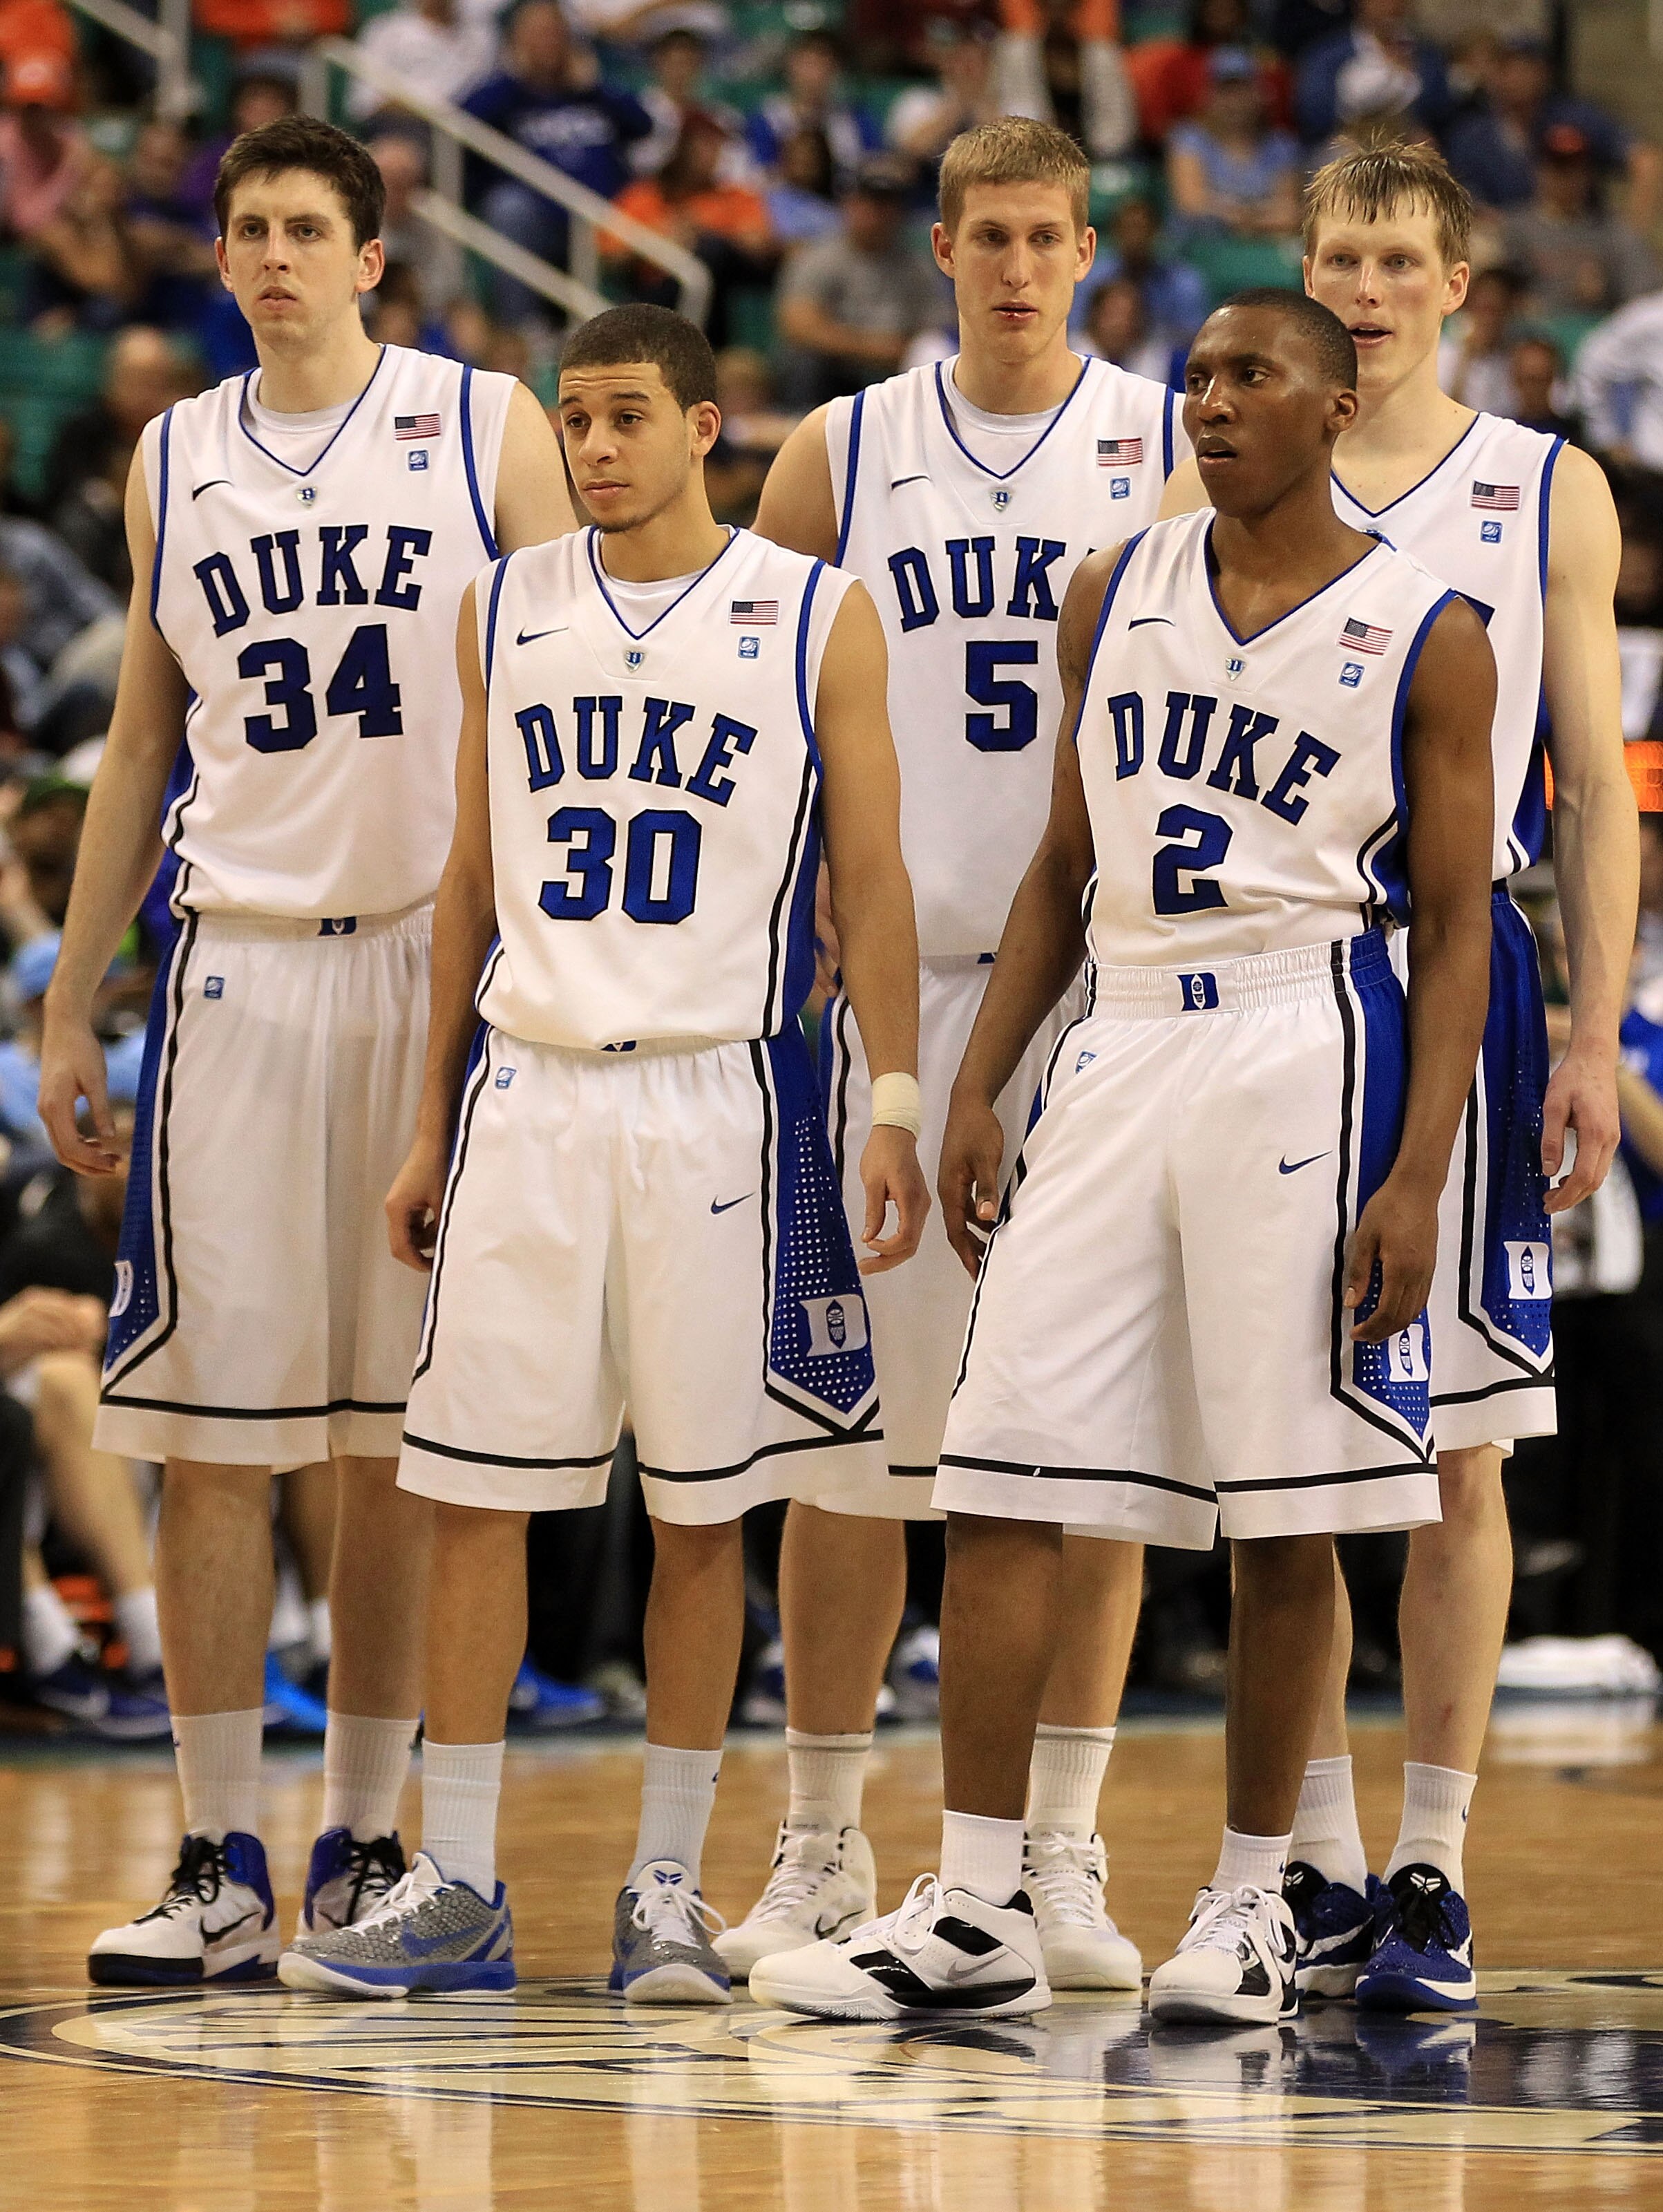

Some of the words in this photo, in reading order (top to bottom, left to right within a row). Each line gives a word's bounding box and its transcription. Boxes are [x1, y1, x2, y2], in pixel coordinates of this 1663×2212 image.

[193, 525, 430, 636] DUKE
[888, 536, 1092, 632] DUK
[238, 624, 403, 753] 34
[966, 641, 1038, 752] 5
[516, 695, 757, 806] DUKE
[1108, 692, 1340, 825] DUKE
[539, 808, 702, 923] 30
[1152, 804, 1233, 914] 2
